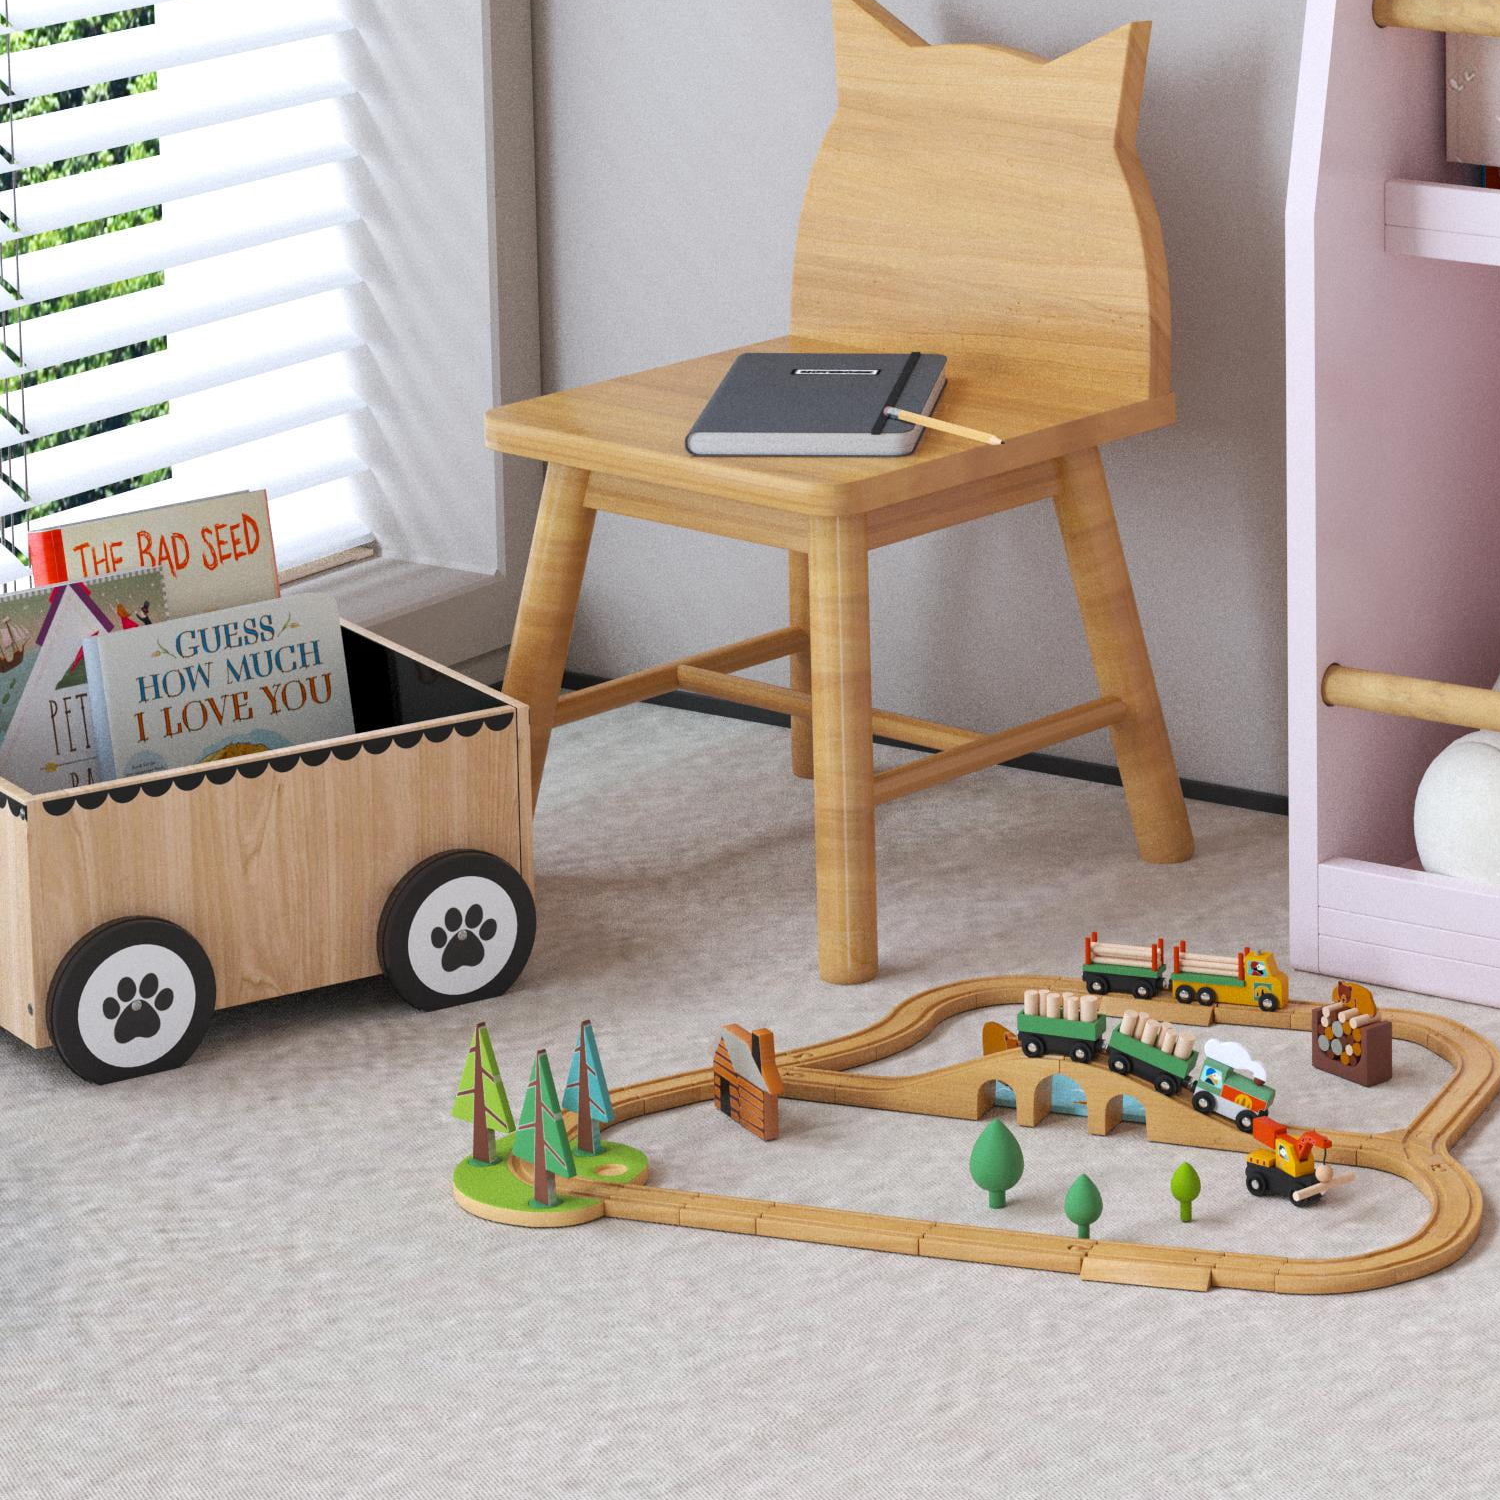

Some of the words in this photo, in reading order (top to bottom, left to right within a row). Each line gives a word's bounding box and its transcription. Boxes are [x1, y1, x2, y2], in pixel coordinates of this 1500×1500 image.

[201, 513, 260, 571] SEED
[175, 614, 275, 659] GUESS
[136, 661, 214, 704] HOW
[226, 639, 324, 685] MUCH
[49, 692, 91, 755] PET
[134, 711, 149, 744] I
[160, 691, 254, 739] LOVE
[259, 672, 333, 716] YOU
